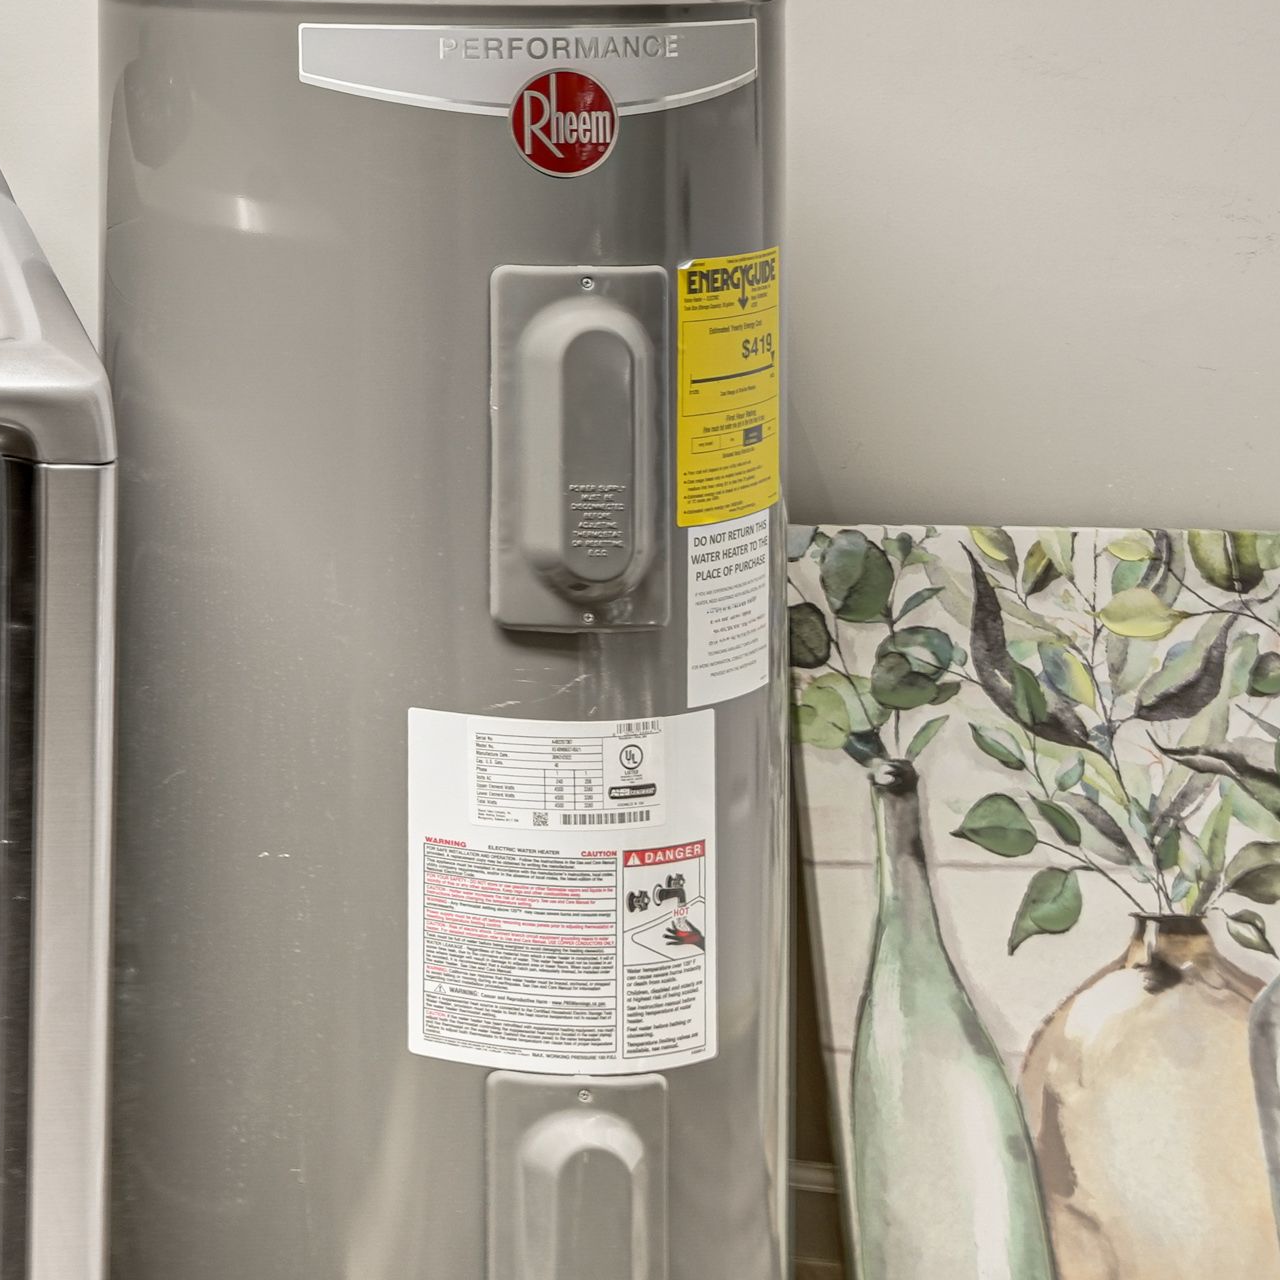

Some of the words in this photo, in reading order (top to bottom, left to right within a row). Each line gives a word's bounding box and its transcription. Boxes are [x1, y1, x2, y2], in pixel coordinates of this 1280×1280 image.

[439, 35, 679, 60] PERFORMANCE
[523, 72, 611, 158] Rheem
[742, 332, 772, 360] $419
[694, 536, 707, 548] DO
[709, 532, 727, 545] NOT
[728, 524, 755, 541] RETURN
[755, 519, 767, 532] THIS
[691, 551, 721, 565] WATER
[722, 543, 749, 560] HEATER
[749, 540, 758, 552] TO
[695, 568, 722, 582] PLACE
[722, 565, 733, 577] OF
[734, 553, 766, 574] PURCHASE
[425, 836, 467, 848] WARNING
[488, 844, 517, 853] ELECTRIC
[644, 844, 701, 864] DANGER
[673, 907, 689, 917] HOT
